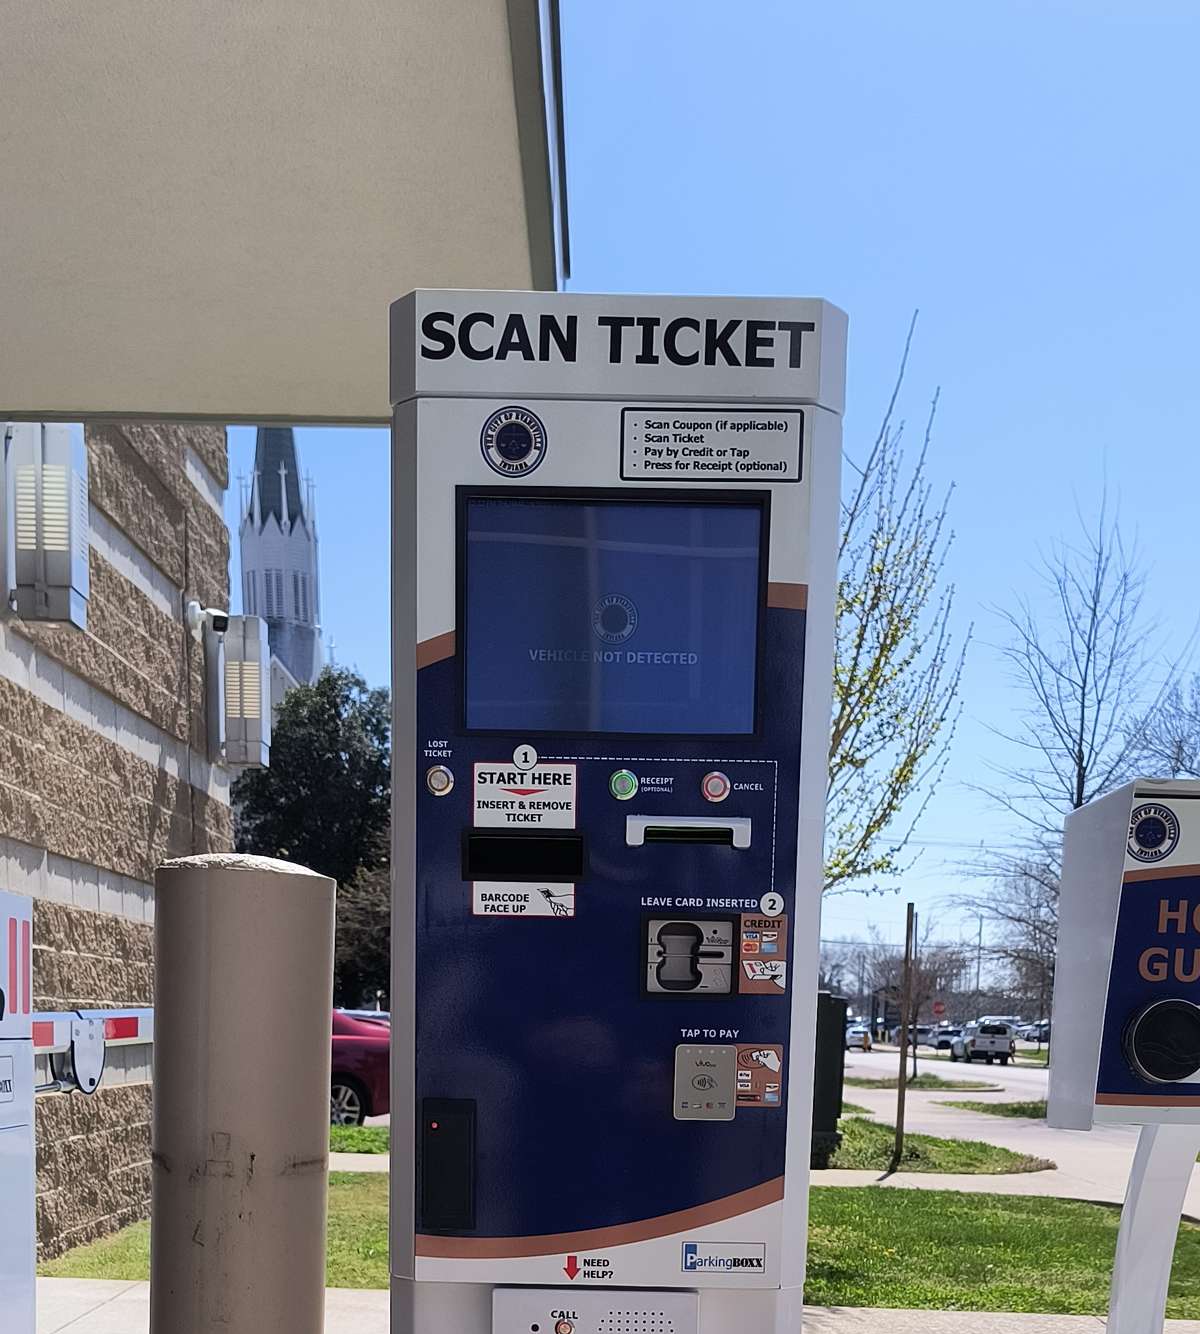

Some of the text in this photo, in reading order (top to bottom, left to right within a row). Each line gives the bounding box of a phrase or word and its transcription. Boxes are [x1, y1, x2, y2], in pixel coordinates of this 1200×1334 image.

[420, 312, 815, 369] SCAN TICKET
[644, 420, 788, 433] Scan Coupon (if applicable)
[644, 434, 704, 443] Scan Ticket
[644, 447, 750, 459] Pay by Credit or Tap
[644, 461, 788, 473] Press for Receipt (optional)
[528, 649, 698, 665] VEHICLE NOT DETECTED
[424, 750, 452, 758] TICKET
[521, 751, 530, 763] 1
[477, 772, 572, 786] START HERE
[641, 777, 674, 785] RECEIPT
[733, 783, 764, 791] CANCEL
[476, 801, 572, 811] INSERT & REMOVE
[505, 814, 543, 823] TICKET
[480, 893, 530, 903] BARCODE
[641, 897, 758, 908] LEAVE CARD INSERTED
[484, 904, 527, 914] FACE UP
[768, 898, 777, 910] 2
[744, 920, 782, 929] CREDIT
[681, 1029, 739, 1038] TAP TO PAY
[583, 1259, 610, 1267] NEED
[686, 1253, 763, 1270] ParkingBOXX
[583, 1270, 613, 1279] HELP?
[551, 1310, 578, 1319] CALL
